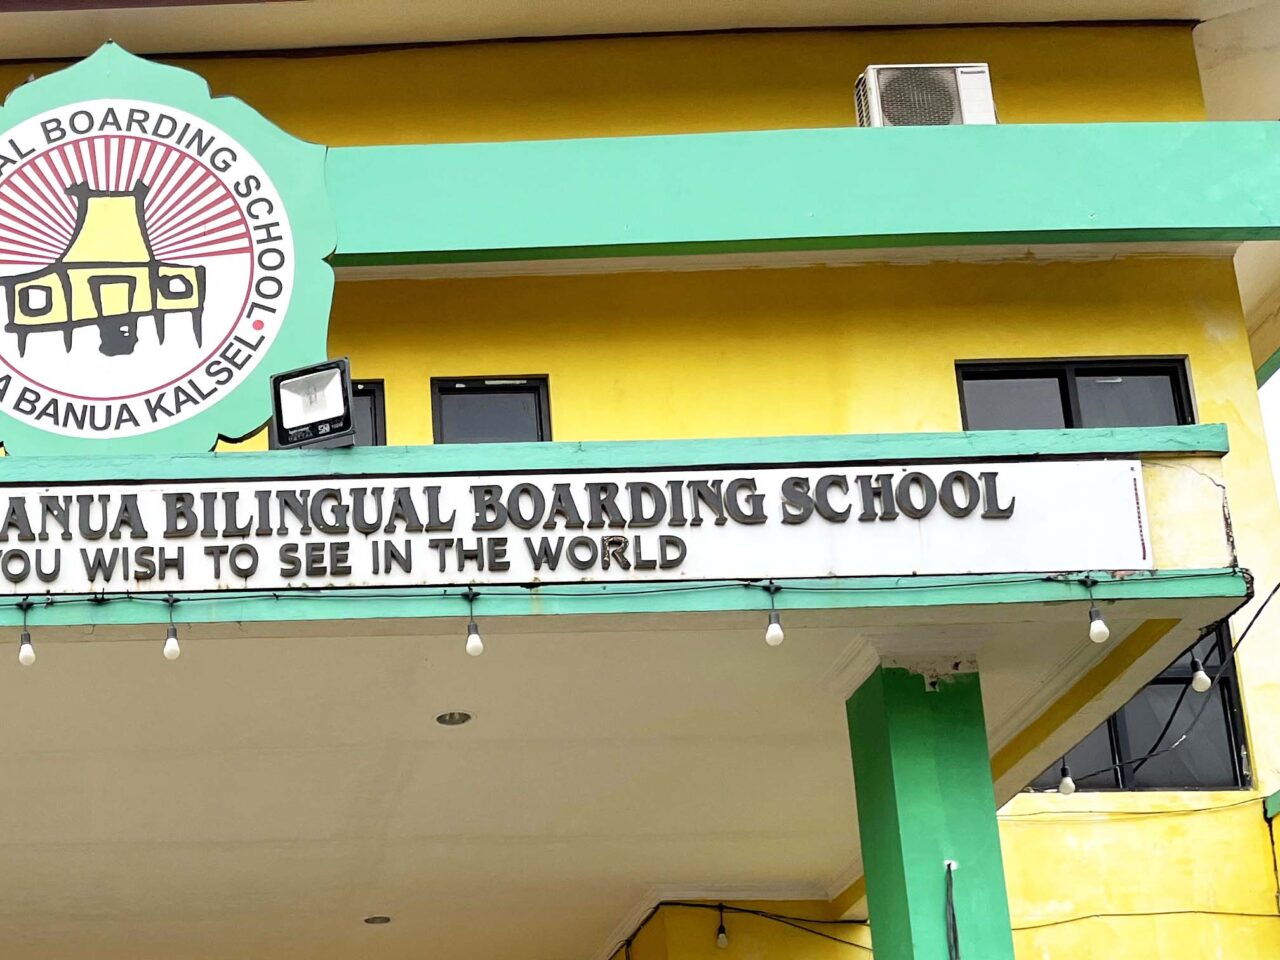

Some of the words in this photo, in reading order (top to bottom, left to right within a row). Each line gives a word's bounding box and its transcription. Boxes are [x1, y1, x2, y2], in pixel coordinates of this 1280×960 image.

[41, 107, 237, 173] BOARDING
[234, 174, 286, 320] SCHOOL
[13, 386, 140, 432] BANUA
[145, 333, 265, 423] KALSEL
[162, 487, 457, 539] BILINGUAL
[469, 477, 768, 531] BOARDING
[779, 470, 1016, 526] SCHOOL
[80, 546, 185, 581] WISH
[204, 543, 259, 579] TO
[279, 541, 352, 577] SEE
[371, 539, 412, 574] IN
[429, 536, 511, 572] THE
[524, 534, 687, 571] WORLD
